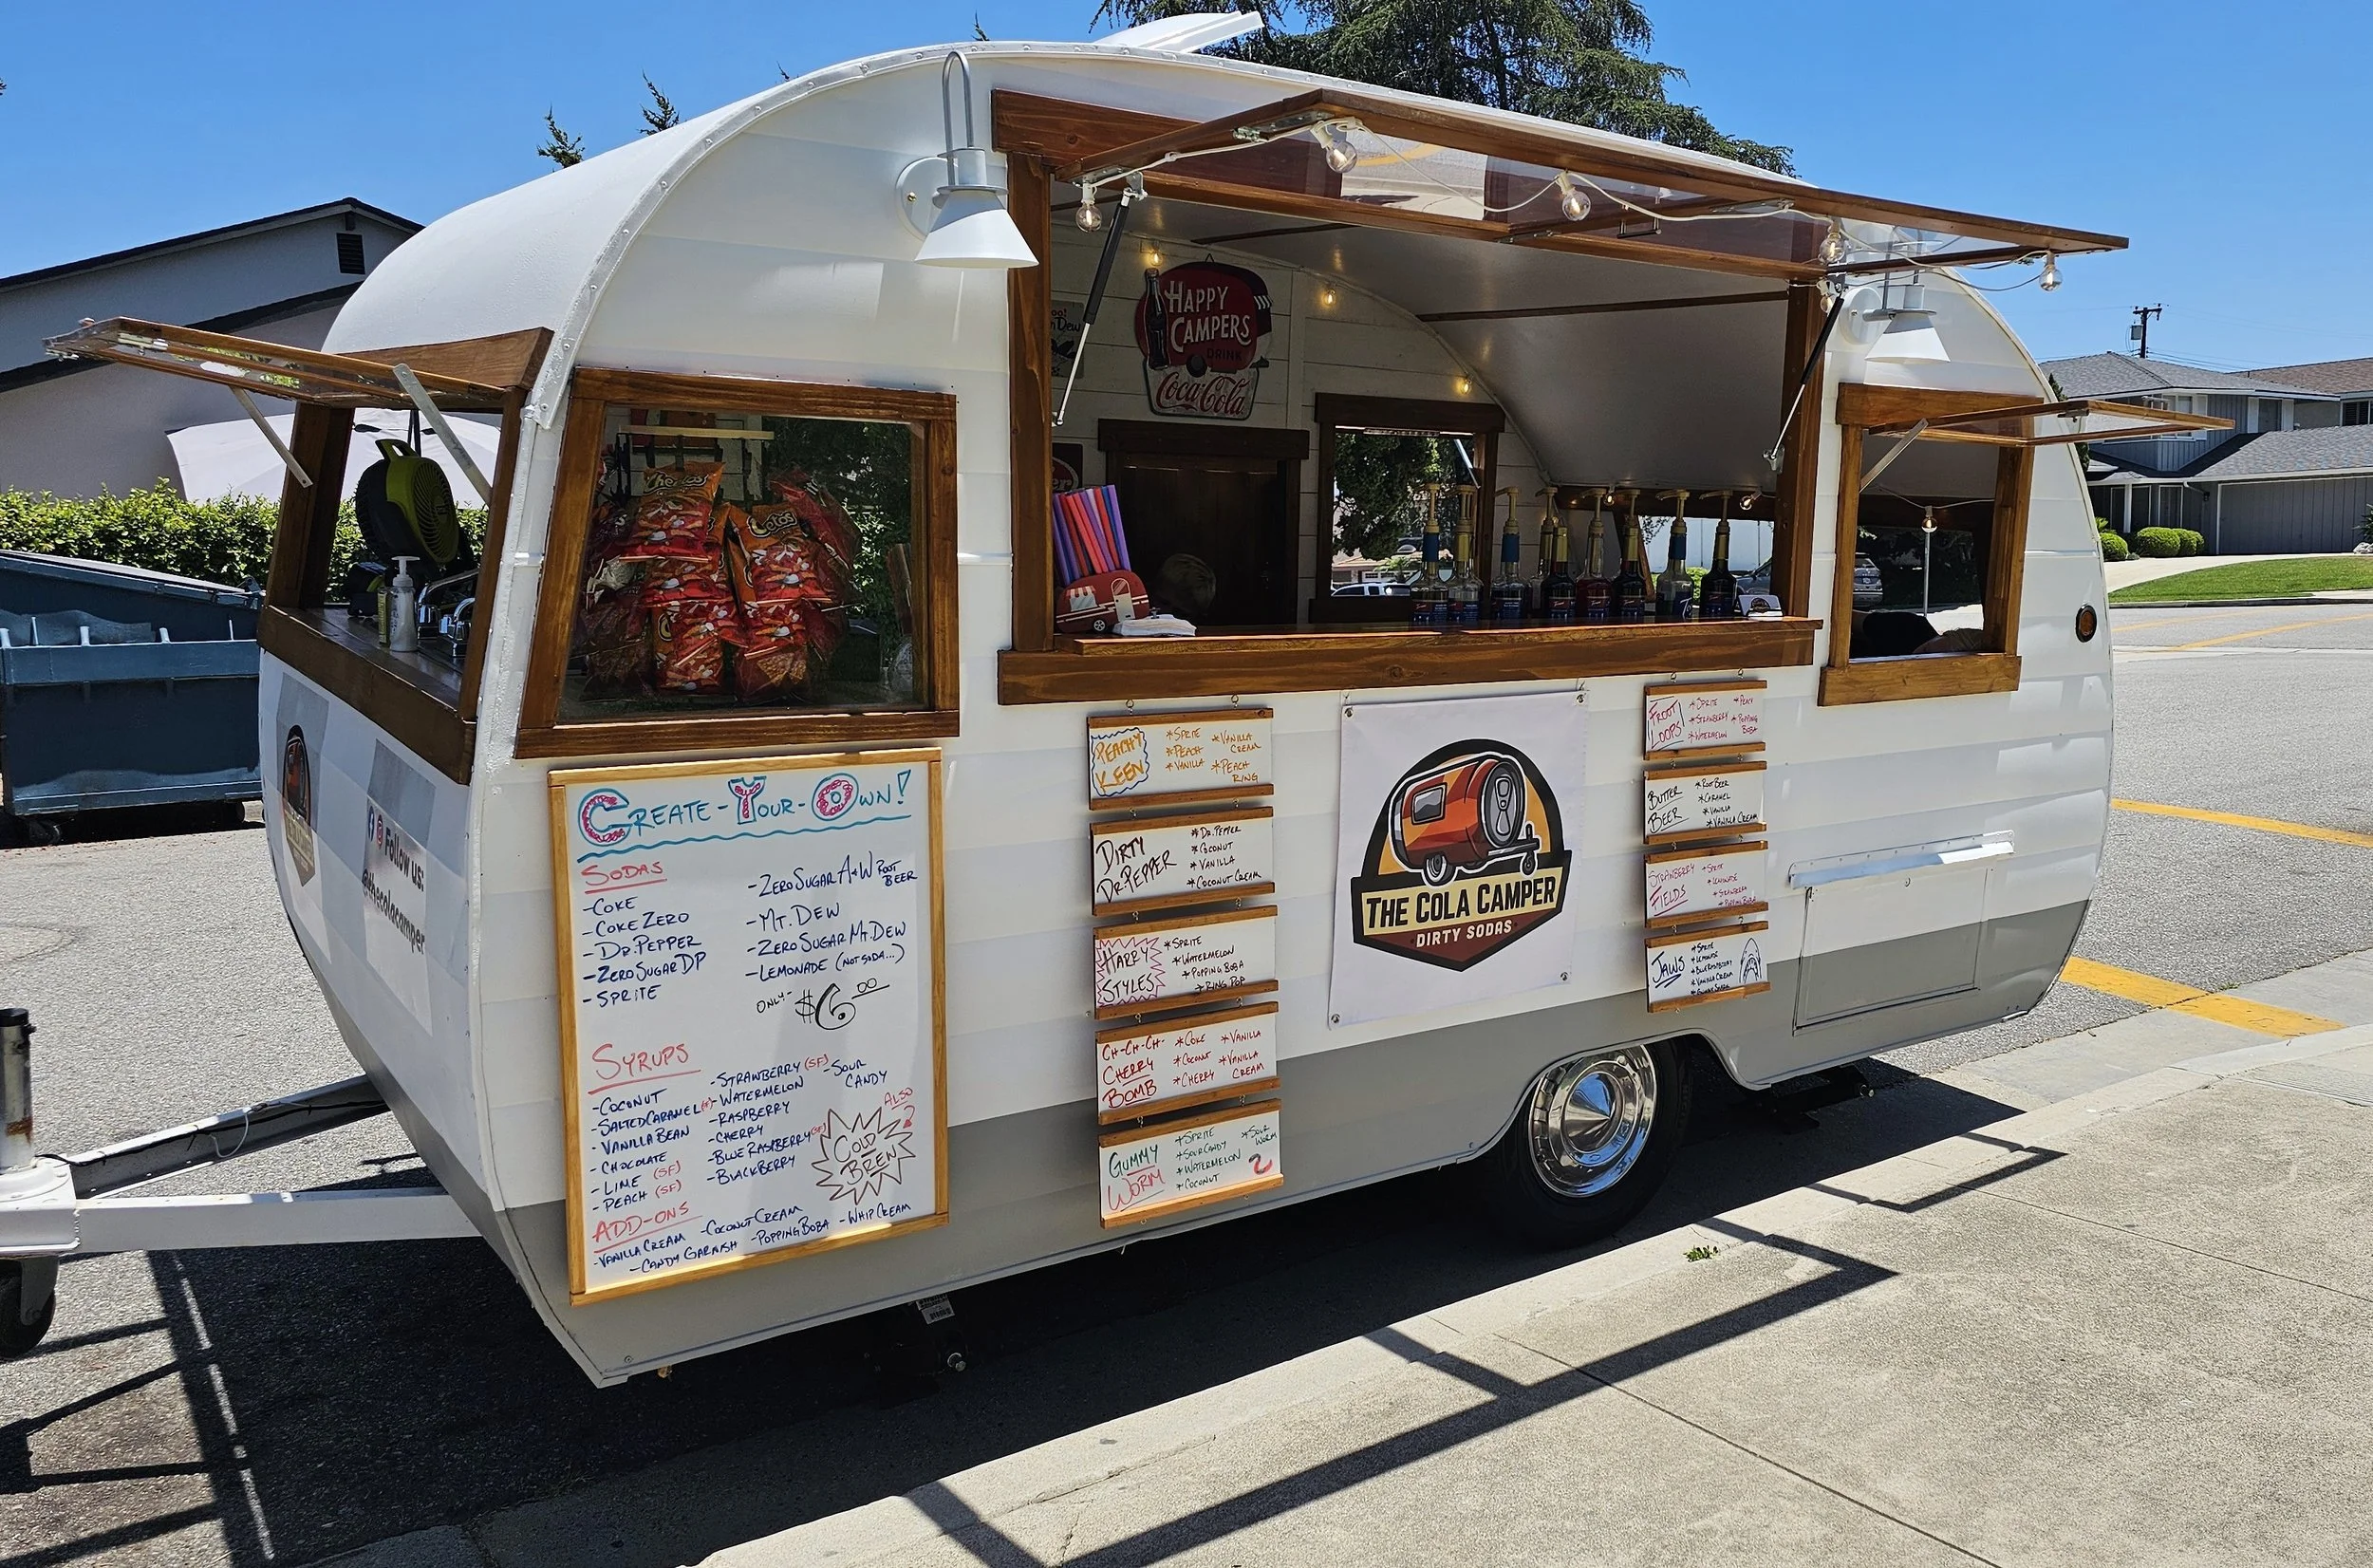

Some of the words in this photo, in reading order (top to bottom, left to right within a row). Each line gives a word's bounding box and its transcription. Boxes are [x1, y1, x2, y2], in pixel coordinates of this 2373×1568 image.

[1165, 280, 1229, 313] HAPPY
[1056, 317, 1081, 332] Dew
[1170, 314, 1252, 353] CAMPERS
[1206, 347, 1243, 362] DRINK
[1156, 371, 1251, 415] Coca-Cola
[1093, 732, 1142, 764] PEACHY
[1220, 732, 1253, 743] VANILLA
[1230, 743, 1261, 753] CREAM
[1651, 721, 1682, 750] LOOPS
[1174, 745, 1204, 757] PEACH
[1175, 758, 1205, 770] VANILLA
[1095, 759, 1145, 792] KEEN
[1220, 759, 1250, 774] PEACH
[1648, 786, 1683, 811] BUTTER
[1648, 807, 1683, 834] BEER
[385, 827, 409, 879] Follow
[1096, 836, 1146, 875] DIRTY
[1200, 841, 1234, 853] COCONUT
[583, 862, 663, 887] SODAS
[1120, 849, 1177, 893] PEPPER
[1199, 856, 1235, 869] VANILLA
[759, 874, 793, 897] ZERO
[794, 868, 837, 890] SUGAR
[882, 870, 918, 887] BEER
[1196, 875, 1232, 889] COCONUT
[1234, 868, 1261, 881] CREAM
[593, 897, 638, 916] COKE
[1366, 897, 1409, 929] THE
[1416, 890, 1470, 924] COLA
[1477, 875, 1556, 916] CAMPER
[1650, 885, 1686, 910] FIELDS
[362, 868, 426, 955] @thecolacamper
[596, 920, 638, 937] COKE
[643, 911, 689, 928] ZERO
[791, 903, 840, 926] DEW
[633, 935, 701, 955] PEPPER
[757, 940, 797, 956] ZERO
[799, 932, 847, 952] SUGAR
[869, 921, 906, 941] DEW
[1171, 936, 1202, 949] SPRITE
[1415, 927, 1462, 948] DIRTY
[1467, 919, 1513, 941] SODAS
[597, 965, 633, 983] ZERO
[636, 961, 677, 981] SUGAR
[674, 952, 706, 975] DP
[1102, 947, 1149, 975] HARRY
[1180, 944, 1235, 965] WATERMELON
[1652, 950, 1686, 982] JAWS
[760, 958, 829, 981] LEMONADE
[1190, 966, 1222, 978] POPPING
[1224, 961, 1244, 972] BOBA
[1102, 973, 1155, 1002] STYLES
[1184, 1031, 1206, 1047] COKE
[1229, 1029, 1261, 1044] VANILLA
[591, 1043, 689, 1080] SYRUPS
[831, 1059, 867, 1076] SOUR
[1181, 1051, 1212, 1066] COCONUT
[1226, 1050, 1259, 1065] VANILLA
[1232, 1063, 1264, 1079] CREAM
[716, 1061, 801, 1089] STRAWBERRY
[804, 1054, 829, 1071] (SF)
[845, 1070, 888, 1089] CANDY
[1103, 1057, 1154, 1086] CHERRY
[1181, 1070, 1215, 1087] CHERRY
[600, 1088, 667, 1115] COCONUT
[719, 1075, 804, 1107] WATERMELON
[885, 1087, 913, 1107] ALSO
[1102, 1080, 1157, 1109] BOMB
[598, 1117, 645, 1136] SALTED
[645, 1104, 701, 1125] CARAMEL
[718, 1100, 790, 1127] RASPBERRY
[601, 1133, 653, 1155] VANILLA
[655, 1125, 690, 1143] BEAN
[712, 1148, 744, 1166] BLUE
[747, 1130, 811, 1159] RASPBERRY
[716, 1125, 764, 1144] CHERRY
[833, 1132, 876, 1163] COLD
[601, 1151, 667, 1175] CHOCOLATE
[717, 1154, 795, 1185] BLACKBERRY
[1109, 1145, 1158, 1179] GUMMY
[1184, 1148, 1241, 1174] WATERMELON
[605, 1175, 642, 1196] LIME
[653, 1160, 681, 1180] (SF)
[1107, 1169, 1166, 1211] WORM
[1185, 1173, 1220, 1189] COCONUT
[603, 1190, 648, 1212] PEACH
[655, 1180, 682, 1199] (SF)
[592, 1202, 689, 1242] ADD-ONS
[704, 1218, 753, 1237] COCONUT
[754, 1205, 803, 1223] CREAM
[848, 1208, 874, 1225] WHIP
[875, 1203, 912, 1220] CREAM
[757, 1225, 800, 1245] POPPING
[800, 1216, 831, 1237] BOBA
[598, 1246, 642, 1269] VANILLA
[643, 1233, 686, 1253] CREAM
[641, 1254, 681, 1274] CANDY
